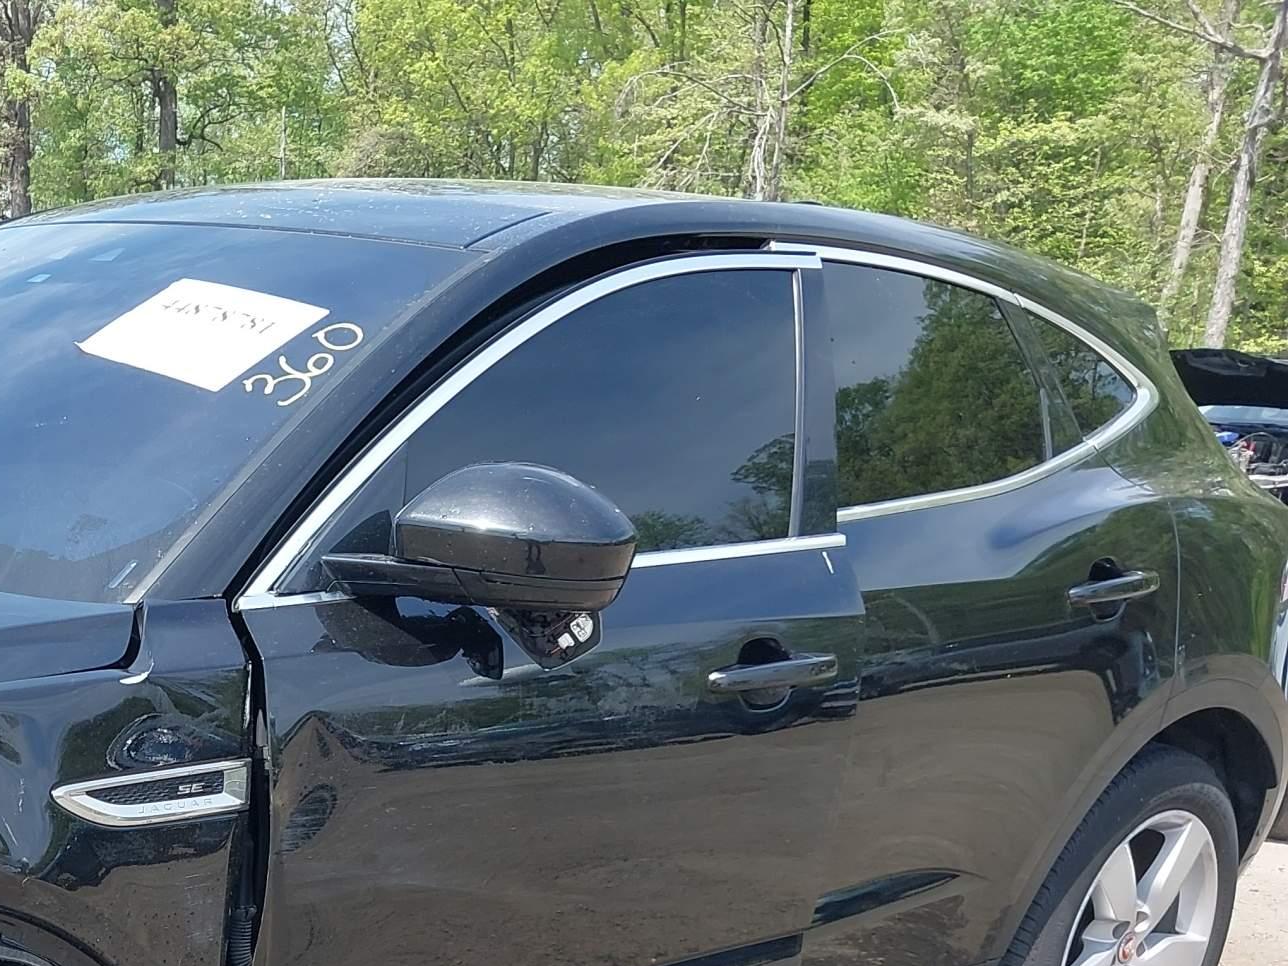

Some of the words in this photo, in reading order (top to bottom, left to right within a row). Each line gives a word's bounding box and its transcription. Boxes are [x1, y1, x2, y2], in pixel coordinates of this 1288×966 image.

[243, 322, 364, 406] 360
[177, 782, 205, 795] SE
[138, 798, 213, 814] JAGUAR
